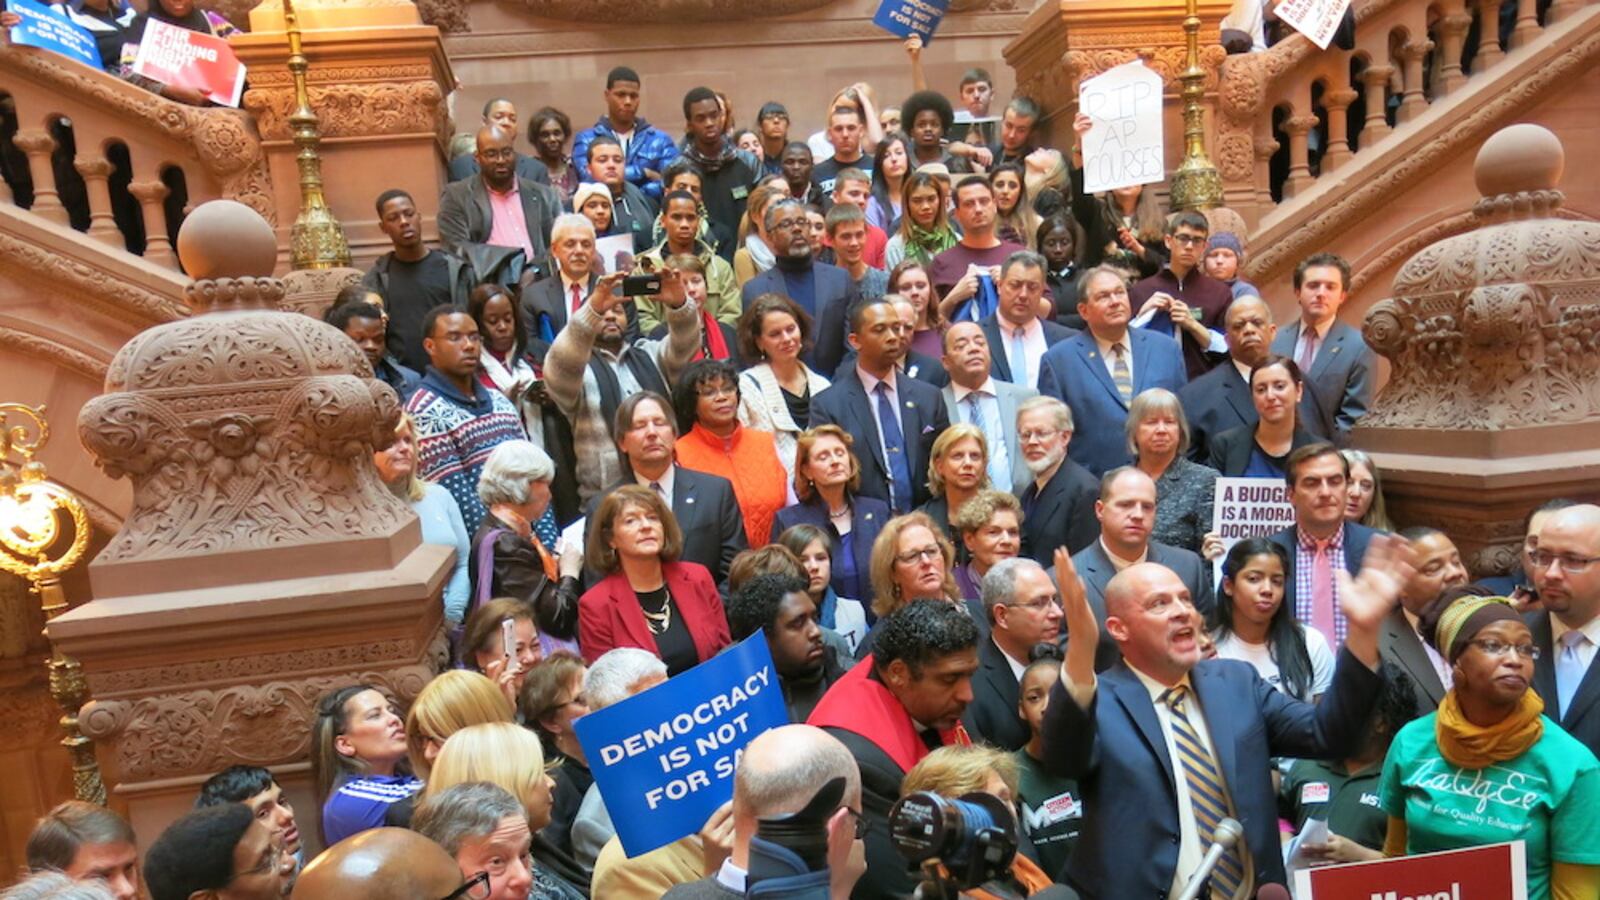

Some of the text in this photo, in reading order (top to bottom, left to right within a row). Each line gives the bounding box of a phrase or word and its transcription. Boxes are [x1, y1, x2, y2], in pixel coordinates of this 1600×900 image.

[889, 10, 911, 26] FOR
[27, 25, 94, 60] FOR SALE
[37, 21, 82, 44] IS NOT
[153, 22, 190, 43] FAIR
[147, 45, 194, 67] RIGHT
[150, 34, 217, 62] FUNDING
[1087, 81, 1152, 121] RIP
[1098, 120, 1137, 156] AP
[1086, 144, 1162, 187] COURSES
[1223, 486, 1291, 503] A BUDGE
[1221, 506, 1295, 521] IS A MORA
[1220, 524, 1287, 539] DOCUME
[600, 665, 769, 767] DEMOCRACY
[659, 712, 749, 773] IS NOT
[645, 748, 744, 810] FOR SA
[1450, 808, 1485, 825] Quality
